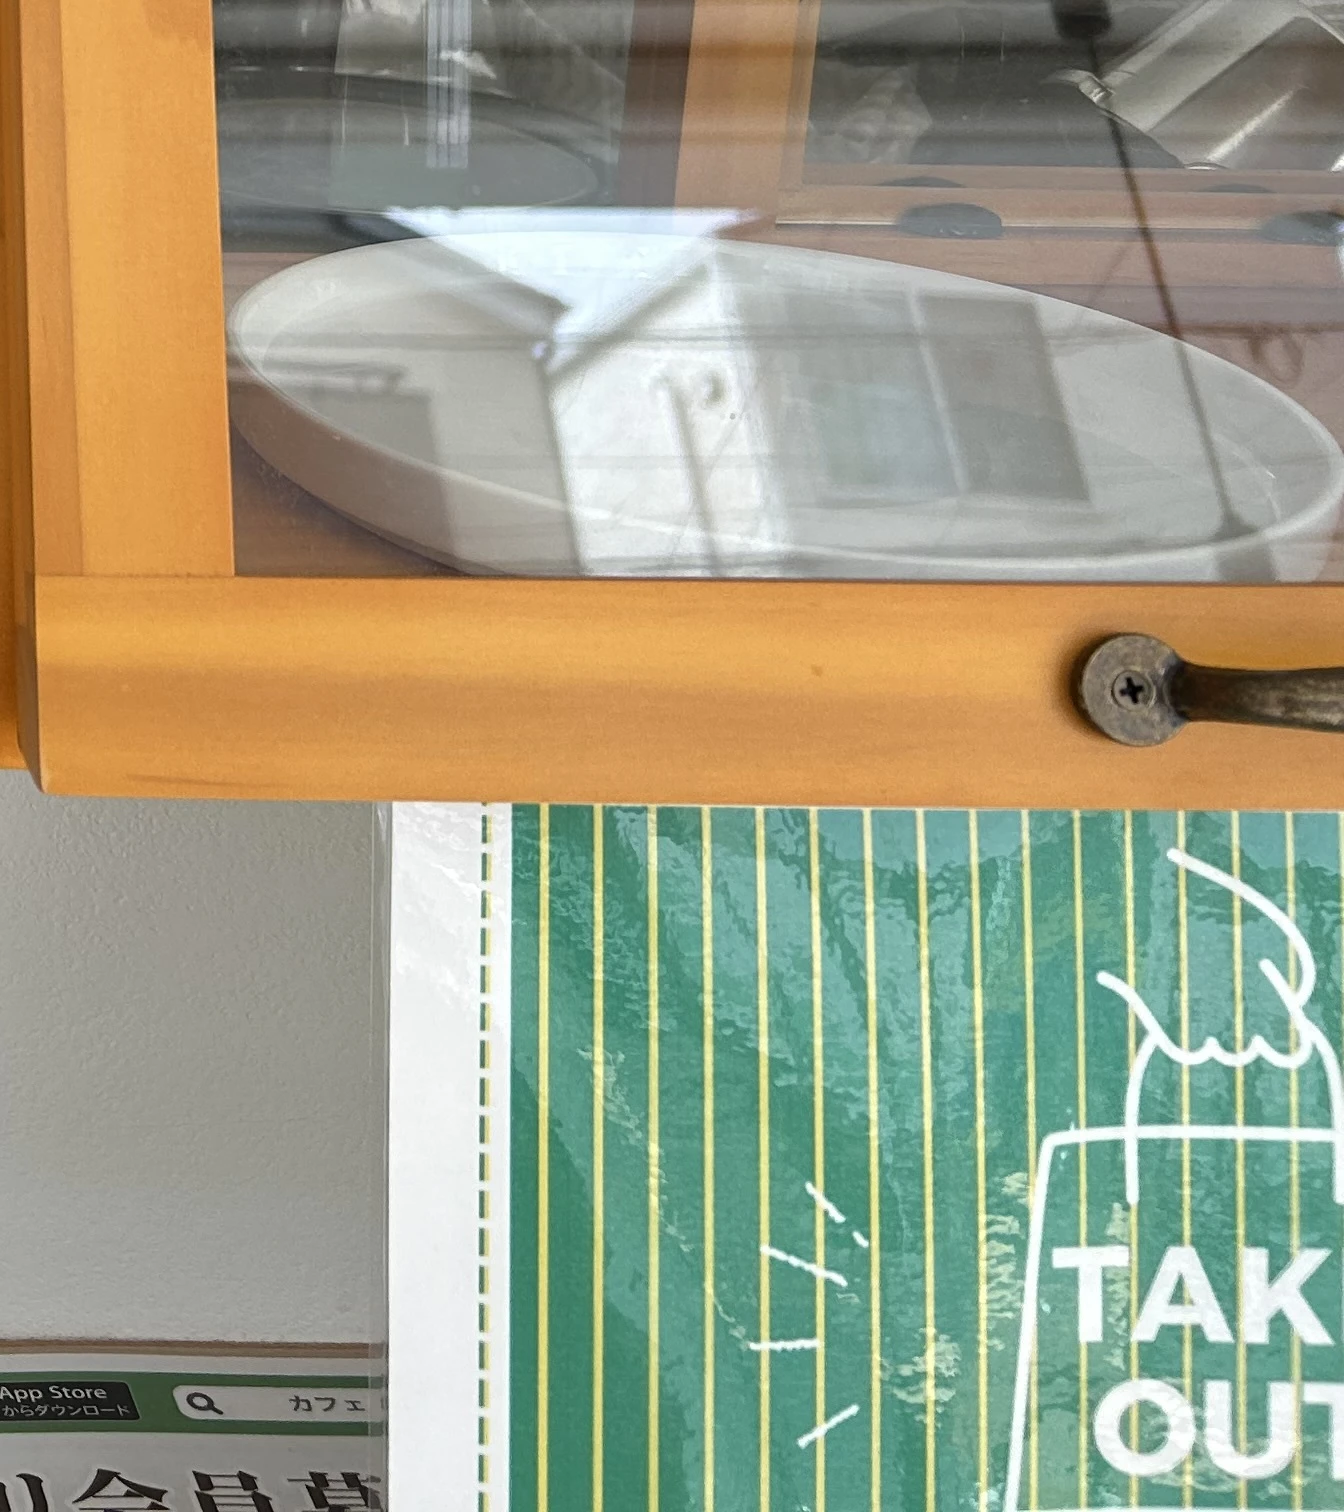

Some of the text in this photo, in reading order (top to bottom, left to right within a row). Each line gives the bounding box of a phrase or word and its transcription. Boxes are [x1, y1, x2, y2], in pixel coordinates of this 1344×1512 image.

[1052, 1245, 1344, 1345] TAK
[49, 1384, 108, 1400] Store
[1, 1402, 132, 1418] からダウンロード
[287, 1393, 367, 1412] カフェ
